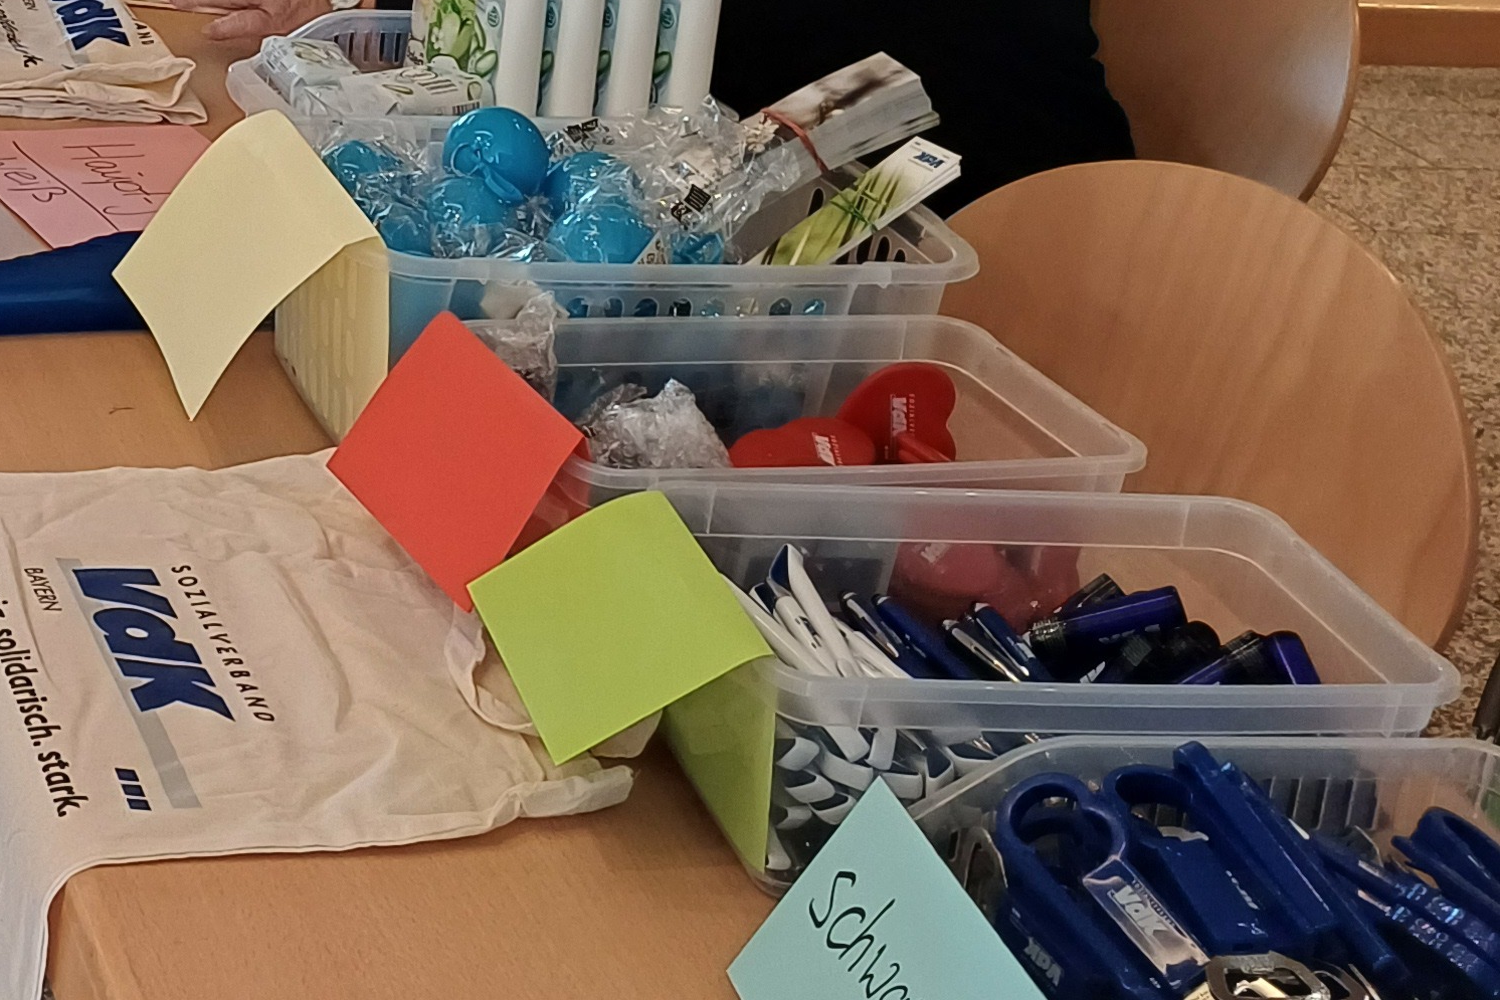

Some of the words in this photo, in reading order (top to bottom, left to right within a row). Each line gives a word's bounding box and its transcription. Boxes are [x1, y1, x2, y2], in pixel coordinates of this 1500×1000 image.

[913, 150, 945, 169] VdK
[23, 566, 63, 613] BAYERN
[71, 567, 236, 723] VdK
[171, 564, 276, 723] SOZIALVERBAND
[1112, 883, 1169, 936] VdK
